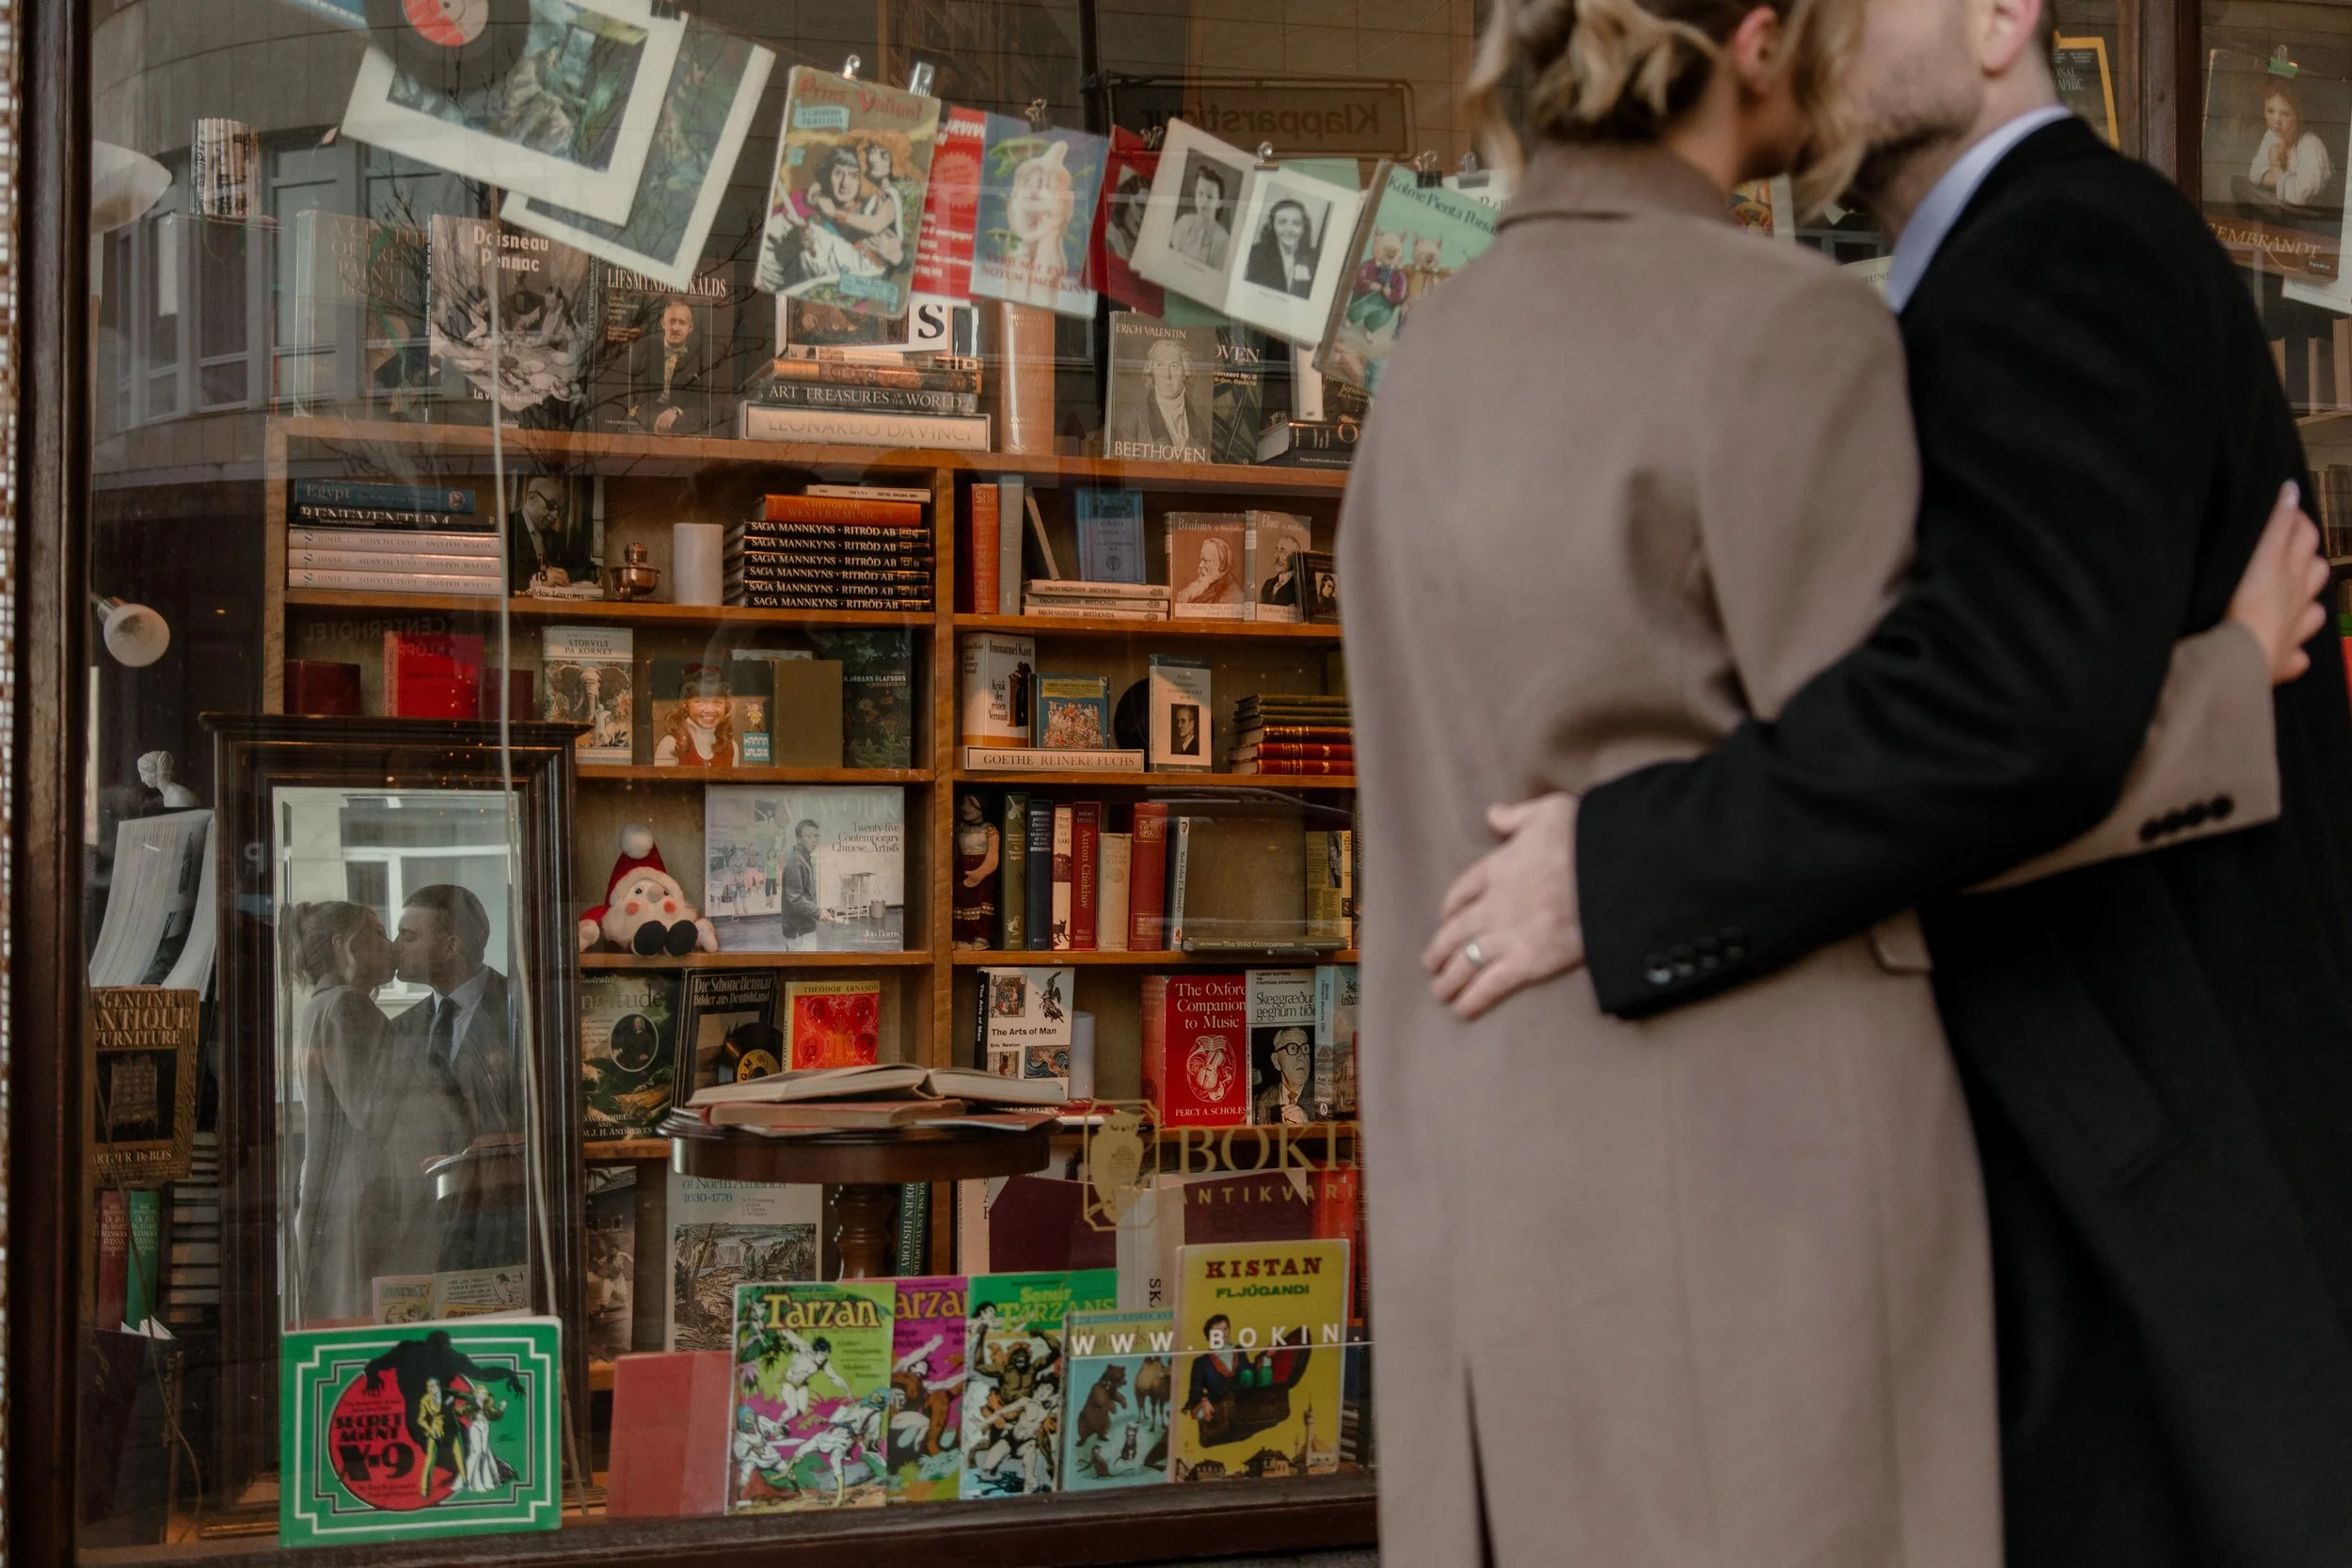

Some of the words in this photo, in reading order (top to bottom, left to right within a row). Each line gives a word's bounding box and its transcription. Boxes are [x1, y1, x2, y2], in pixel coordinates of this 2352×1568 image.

[917, 304, 945, 340] S
[1116, 323, 1142, 335] ERICH
[1144, 325, 1187, 340] VALENTIN
[769, 385, 799, 400] ART
[803, 387, 890, 404] TREASURES
[906, 394, 962, 409] WORLD
[769, 419, 882, 437] LEONARDO
[887, 421, 914, 439] DA
[918, 423, 972, 442] VINCI
[1114, 440, 1206, 463] BEETHOVEN
[305, 483, 351, 502] Egypt
[752, 522, 775, 531] SAGA
[779, 523, 835, 533] MANNKYNS
[882, 528, 896, 537] AB
[1177, 516, 1213, 531] Brahms
[752, 538, 775, 547] SAGA
[779, 540, 835, 550] MANNKYNS
[883, 543, 897, 552] AB
[752, 554, 775, 563] SAGA
[779, 555, 836, 565] MANNKYNS
[883, 558, 897, 567] AB
[750, 567, 773, 576] SAGA
[777, 568, 834, 578] MANNKYNS
[881, 572, 894, 581] AB
[749, 582, 773, 592] SAGA
[777, 581, 834, 594] MANNKYNS
[881, 586, 894, 595] AB
[754, 596, 777, 606] SAGA
[781, 597, 837, 608] MANNKYNS
[885, 601, 898, 610] AB
[1019, 642, 1032, 657] Kant
[983, 753, 1034, 766] GOETHE
[1041, 755, 1094, 766] REINEKE
[1097, 755, 1135, 767] FUCHS
[832, 841, 866, 852] Chinese
[871, 842, 900, 852] Artists
[1081, 830, 1092, 863] Anton
[1080, 863, 1092, 911] Chekhov
[1175, 983, 1202, 996] The
[1177, 998, 1247, 1015] Companion
[1256, 1006, 1296, 1022] gegnum
[1185, 1017, 1198, 1030] to
[1203, 1014, 1240, 1029] Music
[992, 1028, 1008, 1037] The
[1009, 1027, 1027, 1036] Arts
[1029, 1027, 1038, 1036] of
[1040, 1027, 1057, 1036] Man
[1176, 1107, 1200, 1117] PERCY
[1202, 1107, 1210, 1116] A.
[1210, 1105, 1247, 1116] SCHOLES
[900, 1220, 913, 1266] HISTORY
[1205, 1256, 1323, 1279] KISTAN
[1149, 1278, 1162, 1308] SK
[1216, 1282, 1310, 1299] FLJÚGANDI
[762, 1292, 882, 1330] Tarzan
[336, 1442, 415, 1481] X-9
